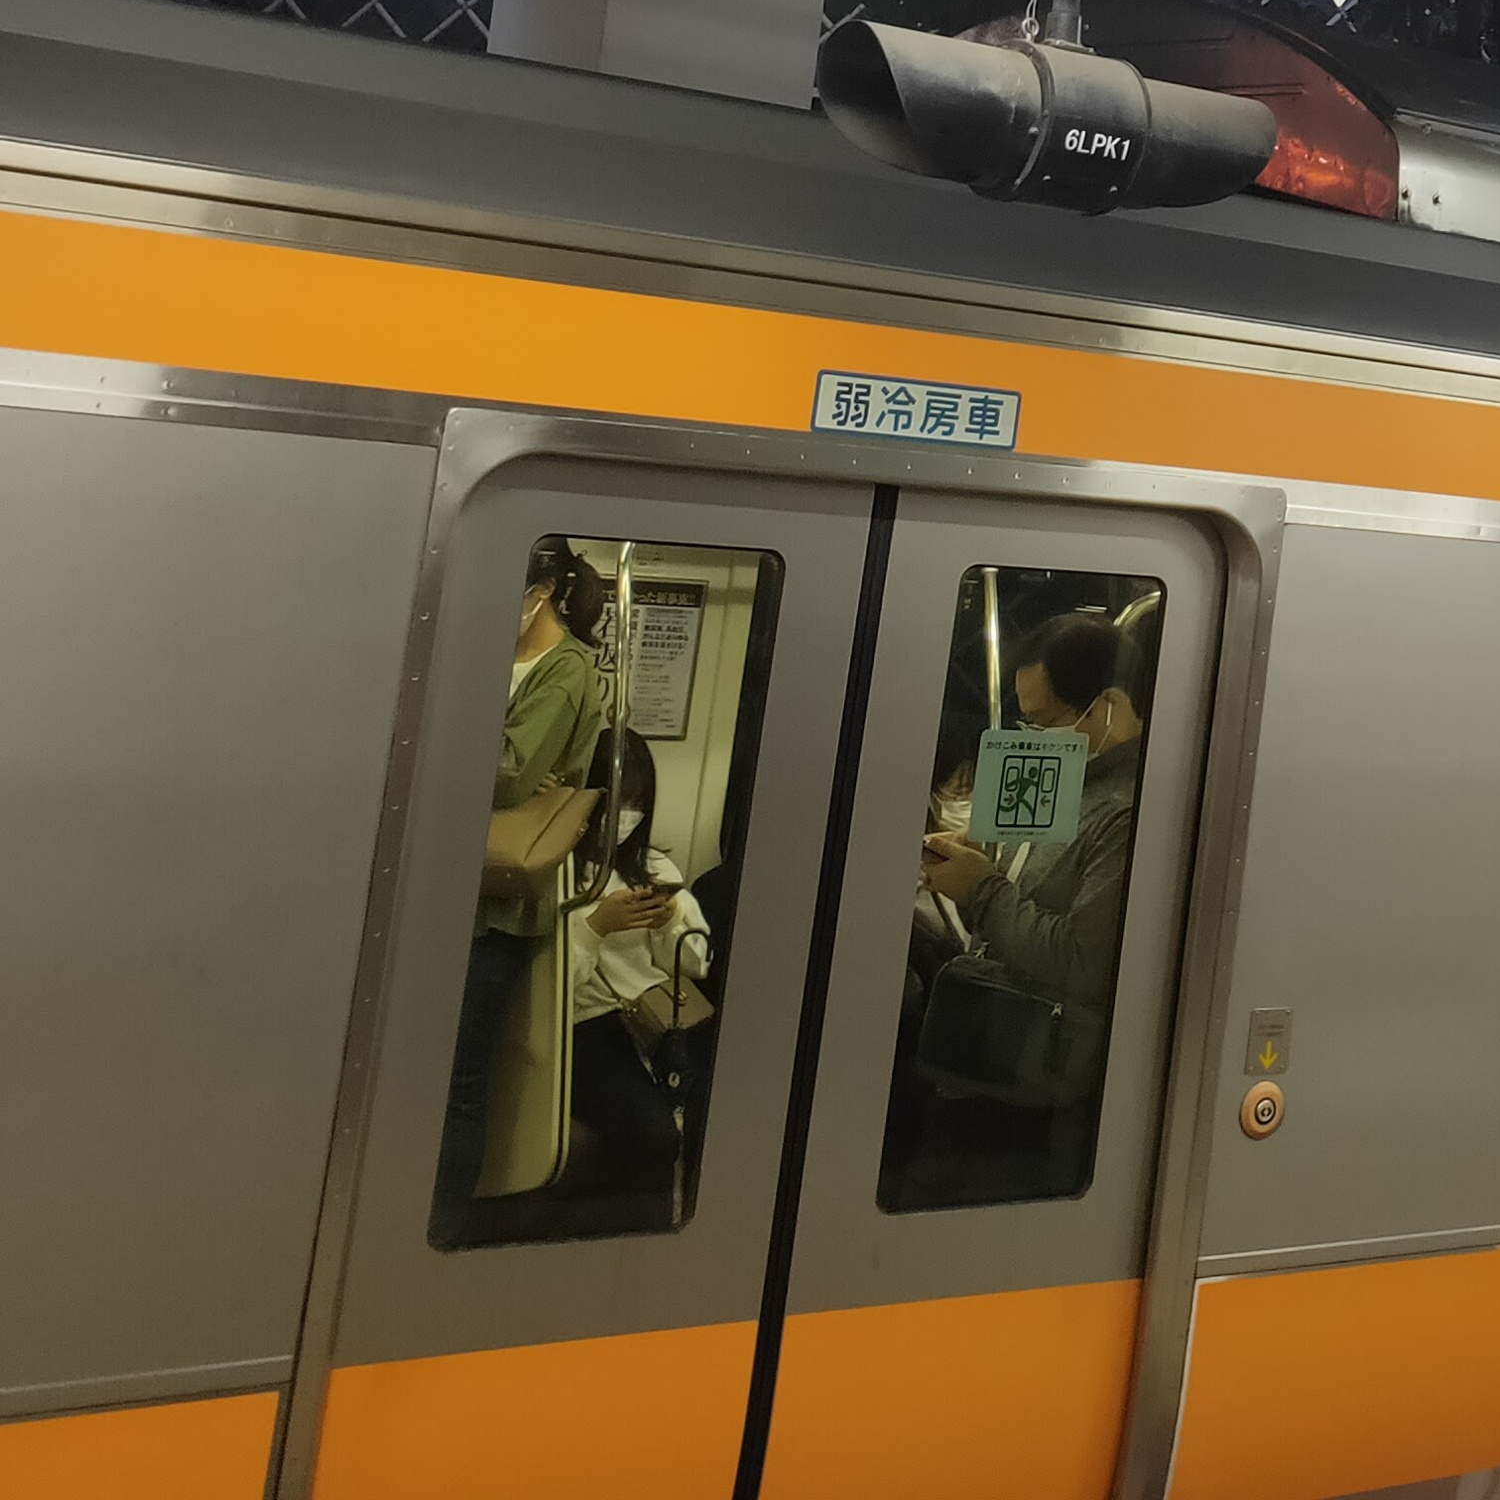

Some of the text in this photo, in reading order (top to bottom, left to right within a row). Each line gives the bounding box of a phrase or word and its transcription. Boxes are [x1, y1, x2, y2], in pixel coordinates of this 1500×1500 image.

[1063, 127, 1132, 162] 6LPK1
[831, 381, 1005, 441] 弱冷房車
